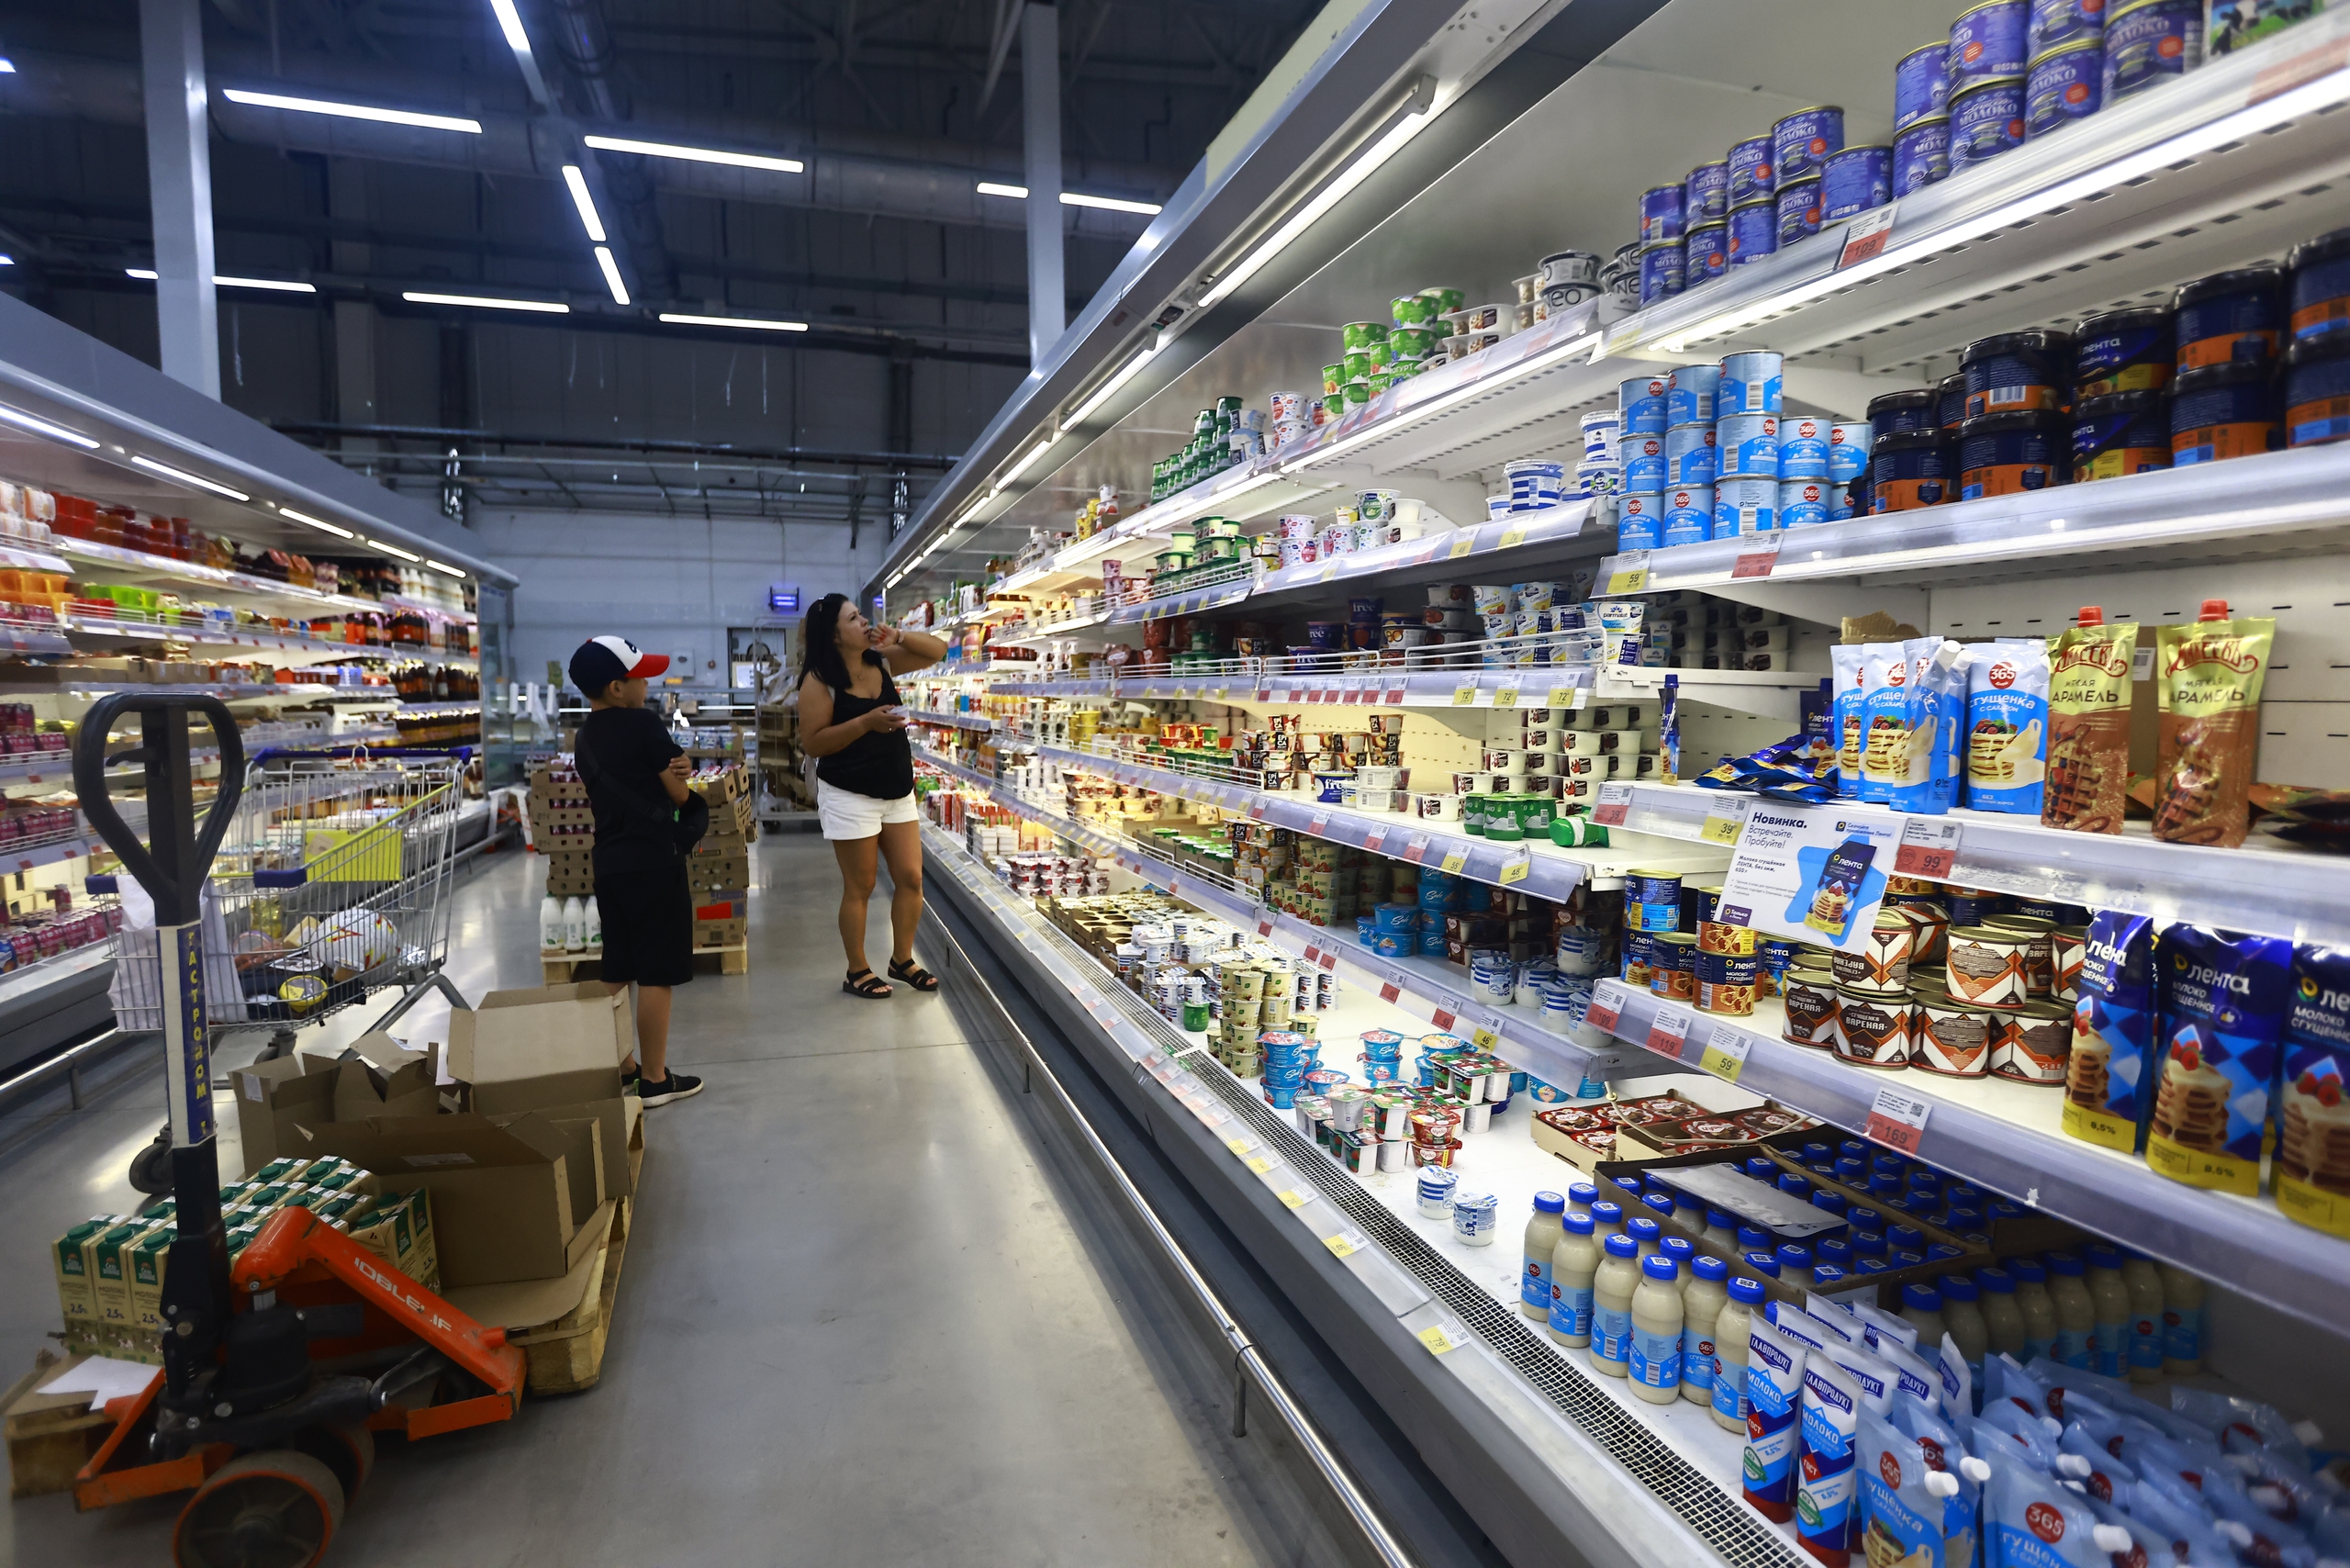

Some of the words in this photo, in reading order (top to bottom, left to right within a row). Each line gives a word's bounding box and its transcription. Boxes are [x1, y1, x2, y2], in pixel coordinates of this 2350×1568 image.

[1959, 102, 2017, 127] МОЛОКО
[1854, 240, 1876, 256] 109
[1799, 426, 1817, 434] 365
[2071, 424, 2096, 439] ента
[1644, 444, 1660, 453] 365
[1675, 496, 1690, 504] 365
[1804, 488, 1819, 498] 365
[1628, 502, 1641, 511] 365
[1629, 573, 1639, 584] 59
[1989, 668, 2016, 681] 365
[2053, 689, 2119, 704] АРАМЕЛЬ
[2169, 689, 2246, 705] АРАМЕЛЬ
[1751, 812, 1808, 829] Новинка.
[1720, 823, 1733, 834] 39
[1747, 824, 1794, 839] Встречайте.
[1744, 835, 1786, 849] Пробуйте!
[1738, 855, 1759, 864] Молоко
[1838, 857, 1864, 870] лента
[1923, 855, 1941, 868] 99
[2020, 905, 2054, 917] лента
[1764, 946, 1789, 957] ента
[2187, 963, 2252, 996] лента
[1788, 998, 1821, 1013] ВАРЕНАЯ
[1845, 1016, 1886, 1031] ВАРЕНАЯ
[2294, 1005, 2346, 1028] МОЛОКО
[1719, 1057, 1732, 1071] 59
[1885, 1126, 1908, 1145] 169
[1433, 1337, 1446, 1348] 79
[1699, 1343, 1714, 1351] 365
[1751, 1337, 1790, 1370] ГЛАВПРОДУКТ
[1748, 1371, 1782, 1404] МОЛОКО
[1806, 1372, 1851, 1409] ГЛАВПРОДУКТ
[1899, 1372, 1927, 1395] РОДУКТ
[1748, 1417, 1762, 1435] ГОСТ
[1802, 1408, 1840, 1444] МОЛОКО
[1803, 1459, 1818, 1476] ГОСТ
[1882, 1456, 1901, 1480] 365
[2029, 1506, 2064, 1536] 365
